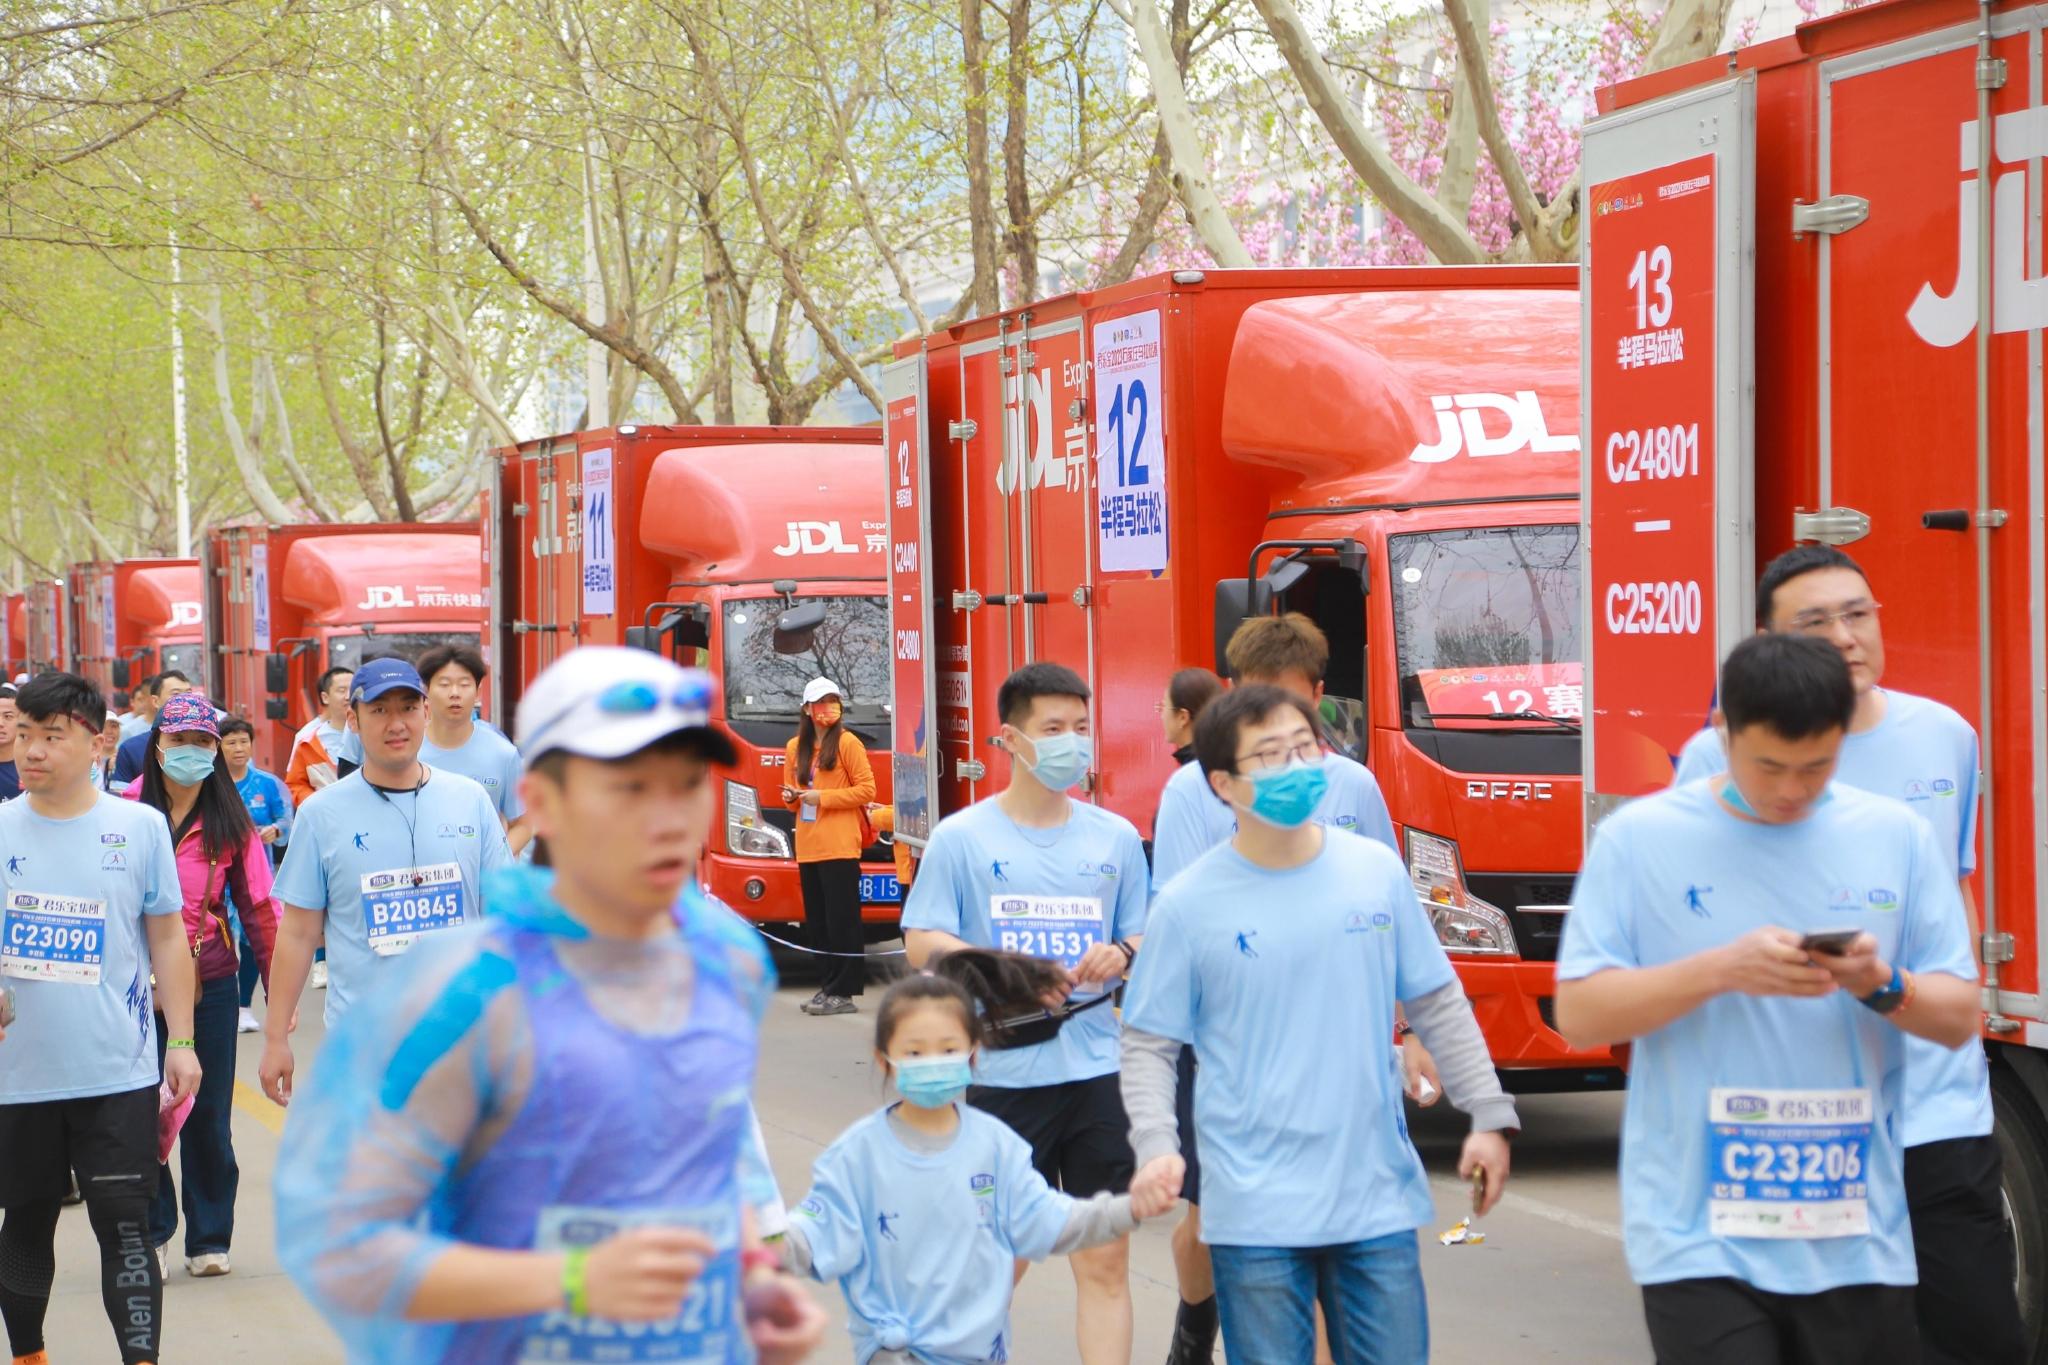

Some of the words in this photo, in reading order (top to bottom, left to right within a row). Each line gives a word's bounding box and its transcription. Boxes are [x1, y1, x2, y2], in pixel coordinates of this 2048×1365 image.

[1628, 245, 1673, 330] 13
[1618, 328, 1684, 370] 半程马拉松
[1108, 379, 1149, 488] 12
[1409, 390, 1581, 463] JDL
[898, 440, 910, 487] 12
[1606, 423, 1699, 484] C24801
[590, 492, 605, 560] 11
[1100, 490, 1162, 539] 半程马拉松
[772, 521, 860, 557] JDL
[357, 585, 415, 610] JDL
[1606, 580, 1702, 635] C25200
[1482, 689, 1538, 716] 12
[43, 899, 99, 915] 君乐宝集团
[372, 893, 457, 925] B20845
[1034, 903, 1094, 916] 君乐宝集团
[11, 923, 98, 951] C23090
[1001, 931, 1094, 956] B21531
[1722, 1142, 1861, 1182] C23206
[124, 1296, 151, 1350] Alen
